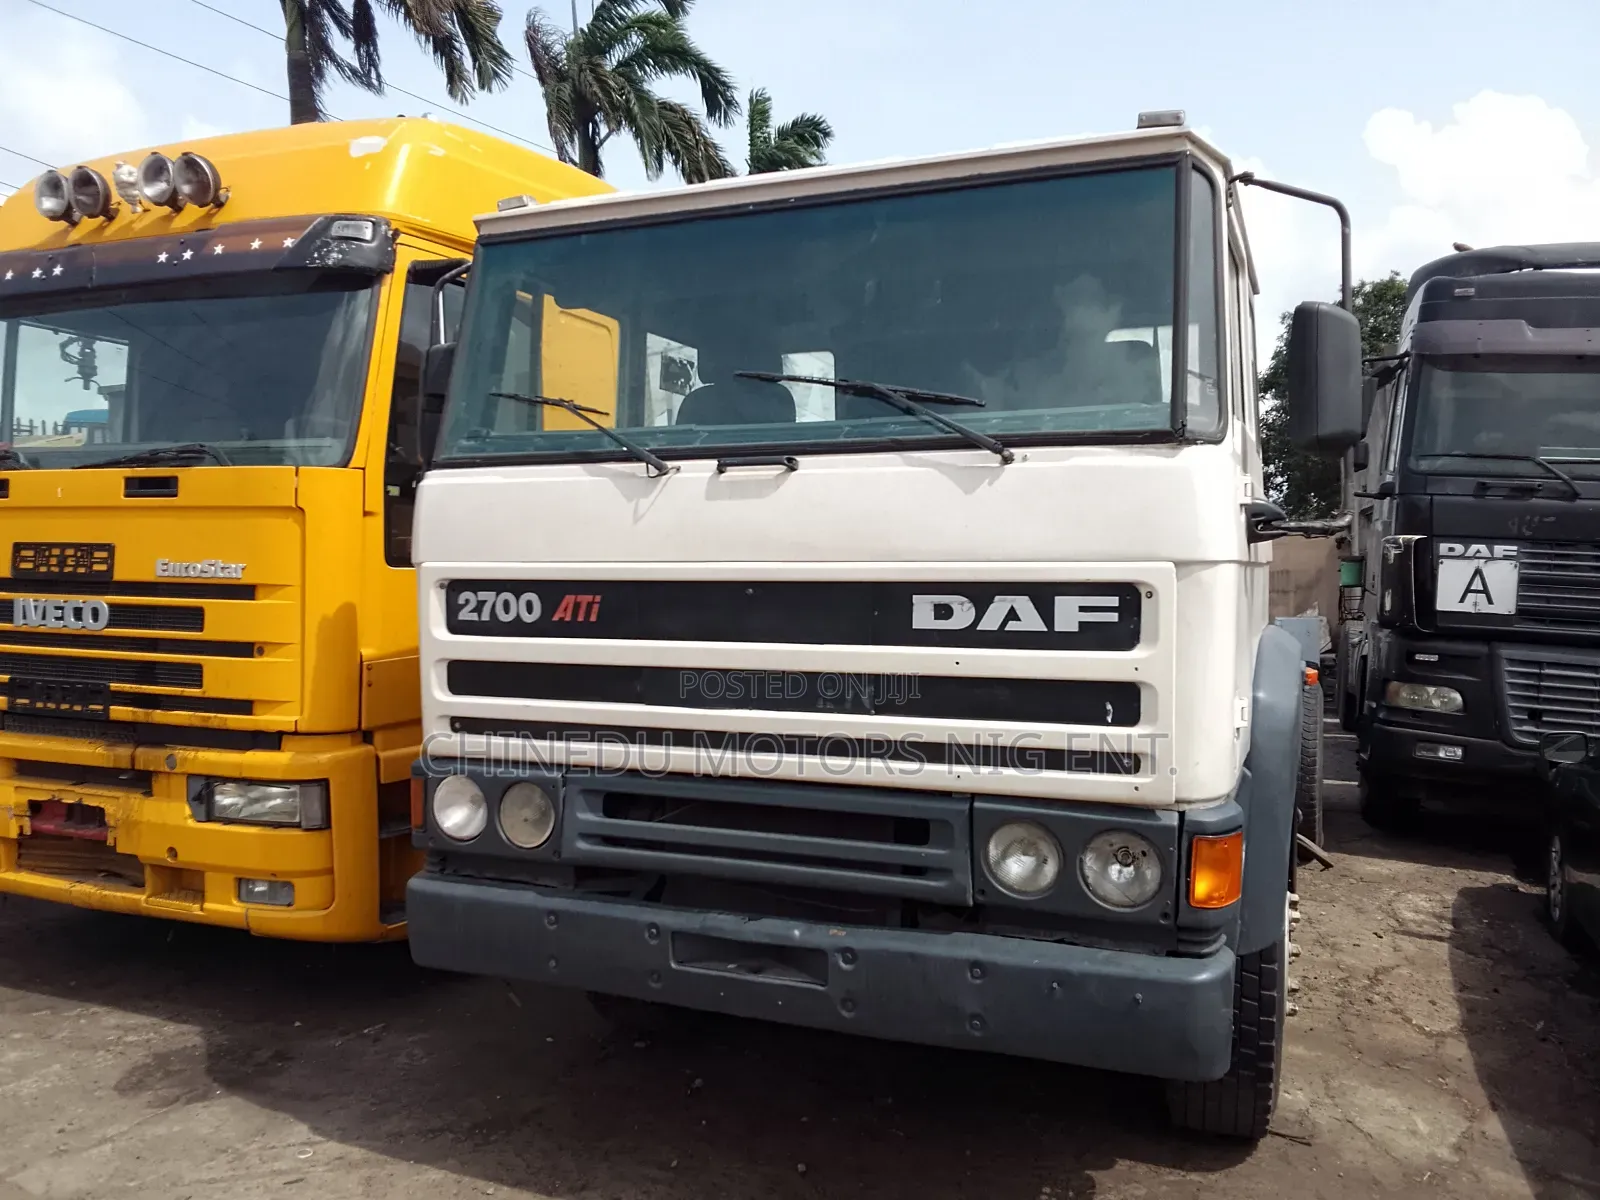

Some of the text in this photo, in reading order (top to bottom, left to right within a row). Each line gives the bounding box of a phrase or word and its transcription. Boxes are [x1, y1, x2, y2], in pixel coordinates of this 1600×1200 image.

[1438, 542, 1519, 559] DAF
[155, 558, 247, 579] EuroStar
[1458, 567, 1495, 605] A
[12, 597, 109, 631] IVECO
[457, 591, 602, 623] 2700 ATi
[911, 593, 1120, 633] DAF
